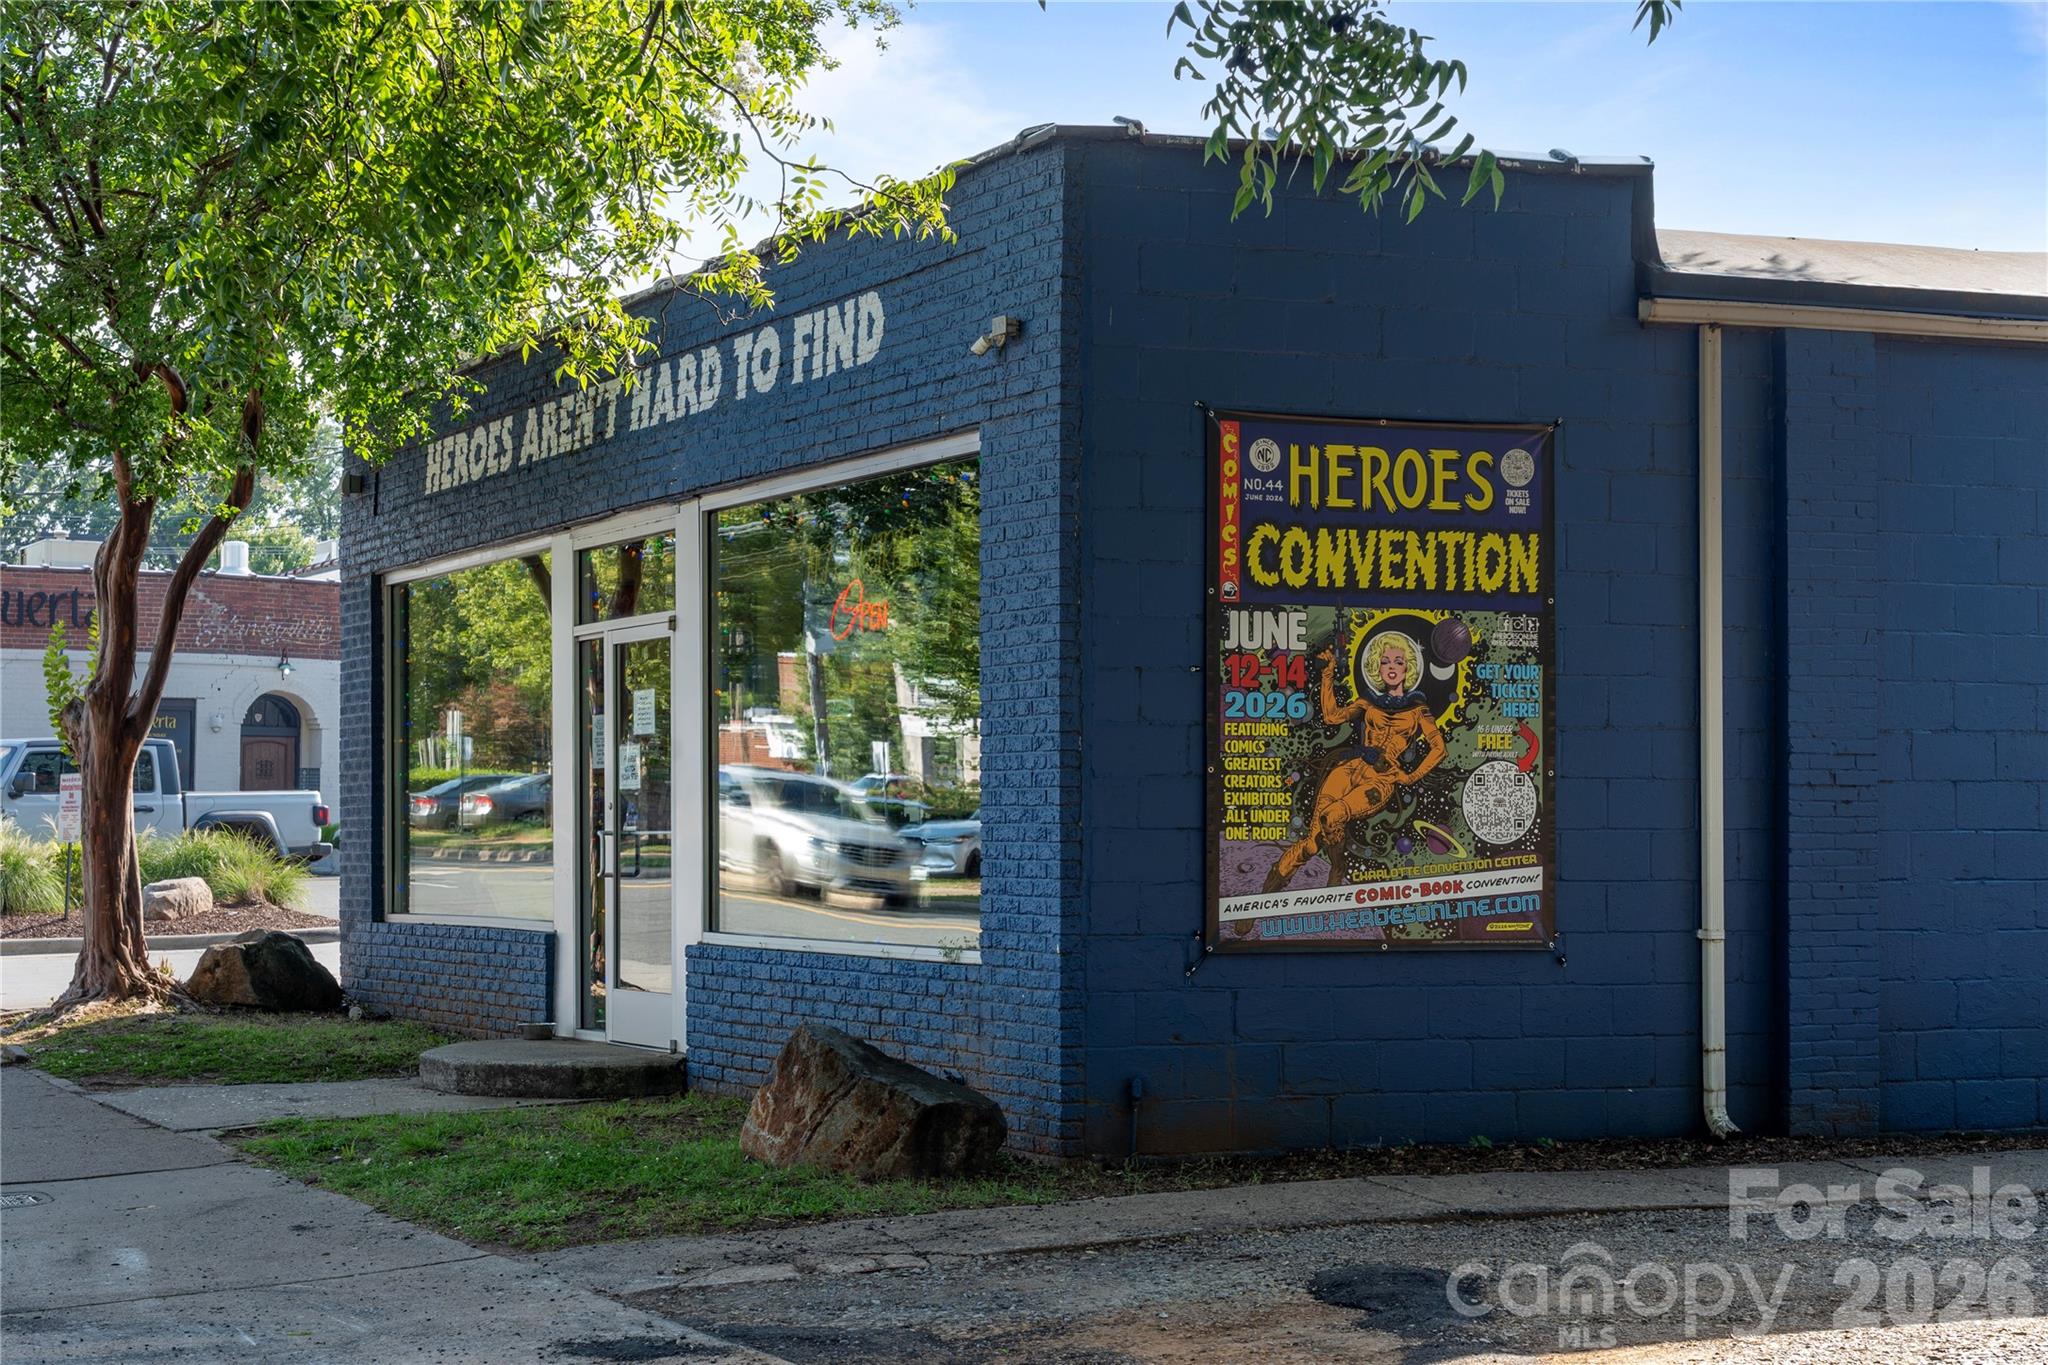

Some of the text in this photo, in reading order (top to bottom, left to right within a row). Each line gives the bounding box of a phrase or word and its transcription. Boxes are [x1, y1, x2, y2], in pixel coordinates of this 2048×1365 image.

[424, 291, 886, 495] HEROES AREN'T HARD TO FIND
[1257, 447, 1272, 463] NC
[1244, 478, 1284, 491] NO.44
[1289, 443, 1494, 513] HEROES
[1221, 433, 1238, 566] COMICS
[1245, 493, 1284, 502] JUNE 2026
[1506, 489, 1529, 498] TICKETS
[1505, 498, 1530, 506] ON SALE
[1247, 522, 1540, 593] CONVENTION
[1224, 610, 1308, 650] JUNE
[1224, 653, 1308, 689] 12-14
[1476, 663, 1539, 680] GET YOUR
[1490, 683, 1540, 699] TICKETS
[1224, 691, 1308, 719] 2026
[1502, 702, 1540, 717] HERE!
[1224, 722, 1289, 737] FEATURING
[1491, 724, 1514, 734] UNDER
[1224, 740, 1265, 753] COMICS
[1477, 734, 1513, 750] FREE
[1224, 757, 1281, 771] GREATEST
[1224, 774, 1282, 788] CREATORS
[1224, 792, 1292, 806] EXHIBITORS
[1225, 809, 1290, 823] ALL UNDER
[1225, 826, 1287, 840] ONE ROOF!
[1352, 854, 1538, 882] CHARLOTTE CONVENTION CENTER
[1223, 873, 1541, 914] AMERICA'S FAVORITE COMIC-BOOK CONVENTION!
